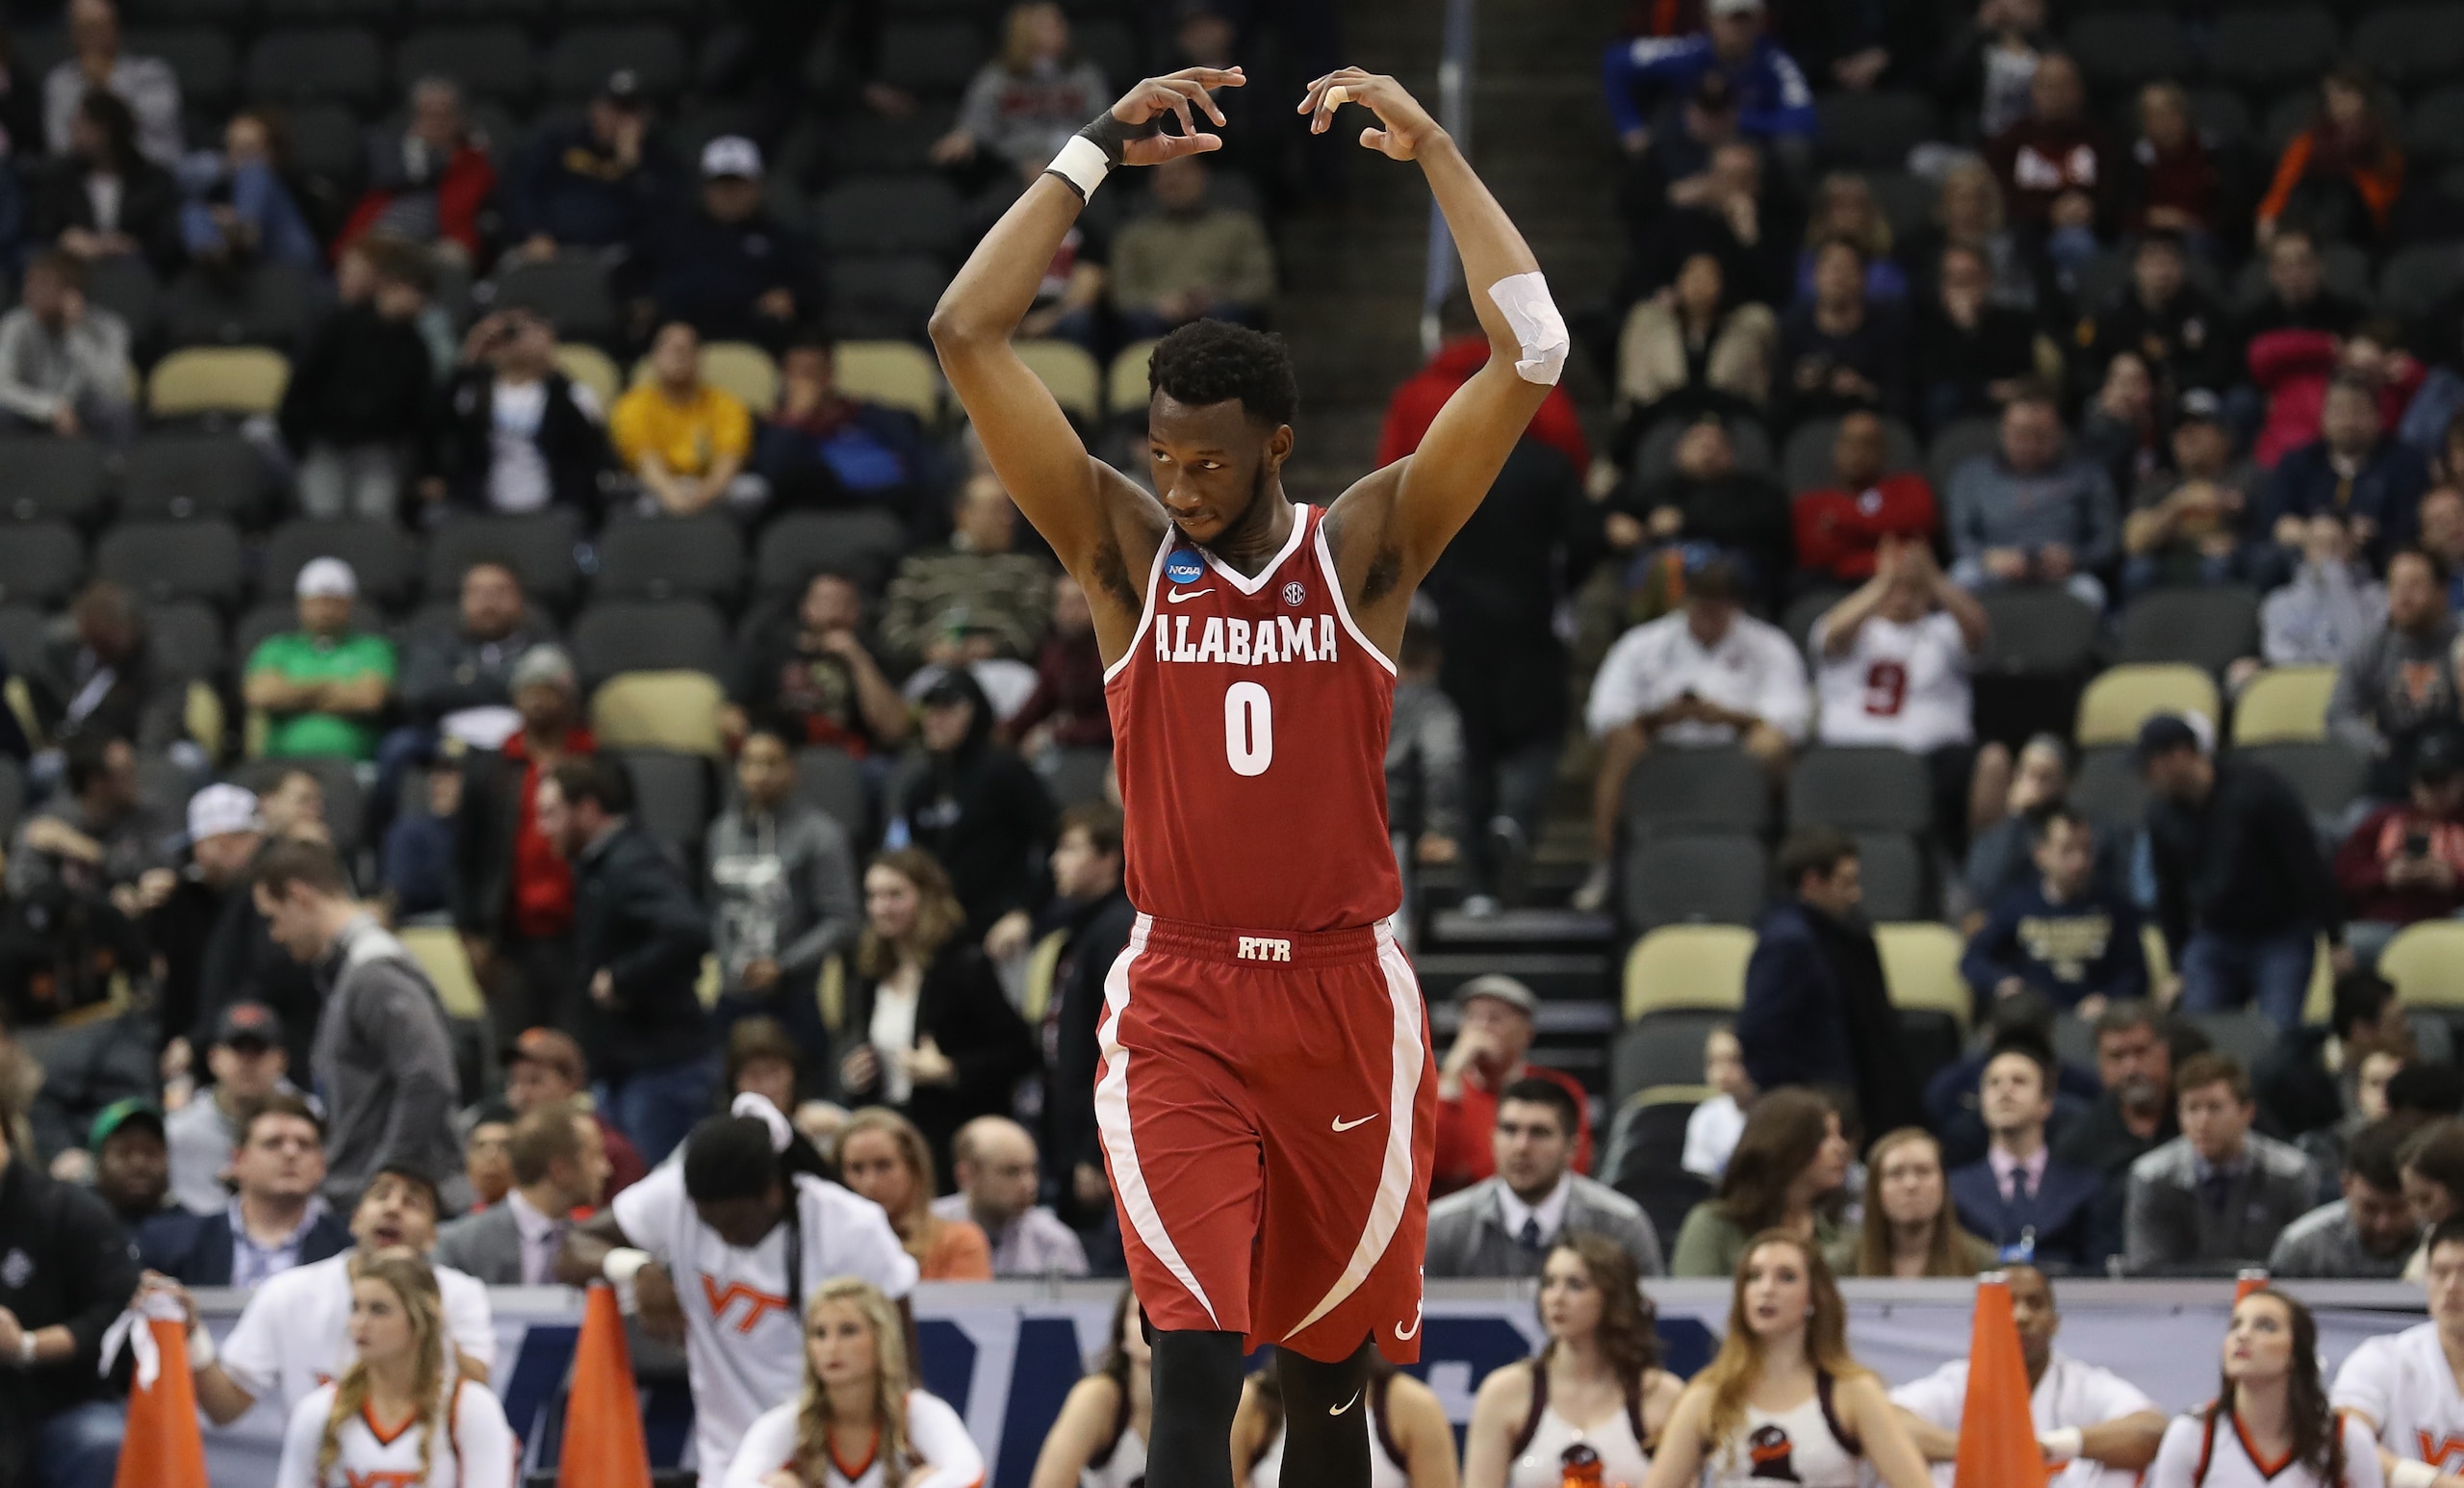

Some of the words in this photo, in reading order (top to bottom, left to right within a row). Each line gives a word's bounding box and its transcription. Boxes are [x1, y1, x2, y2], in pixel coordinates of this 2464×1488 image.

[1168, 565, 1201, 576] NCAA
[1285, 583, 1303, 604] SEC
[1156, 614, 1337, 665] ALABAMA
[1864, 658, 1908, 717] 9
[1224, 680, 1272, 777] 0
[1237, 936, 1291, 962] RTR
[700, 1271, 791, 1335] VT
